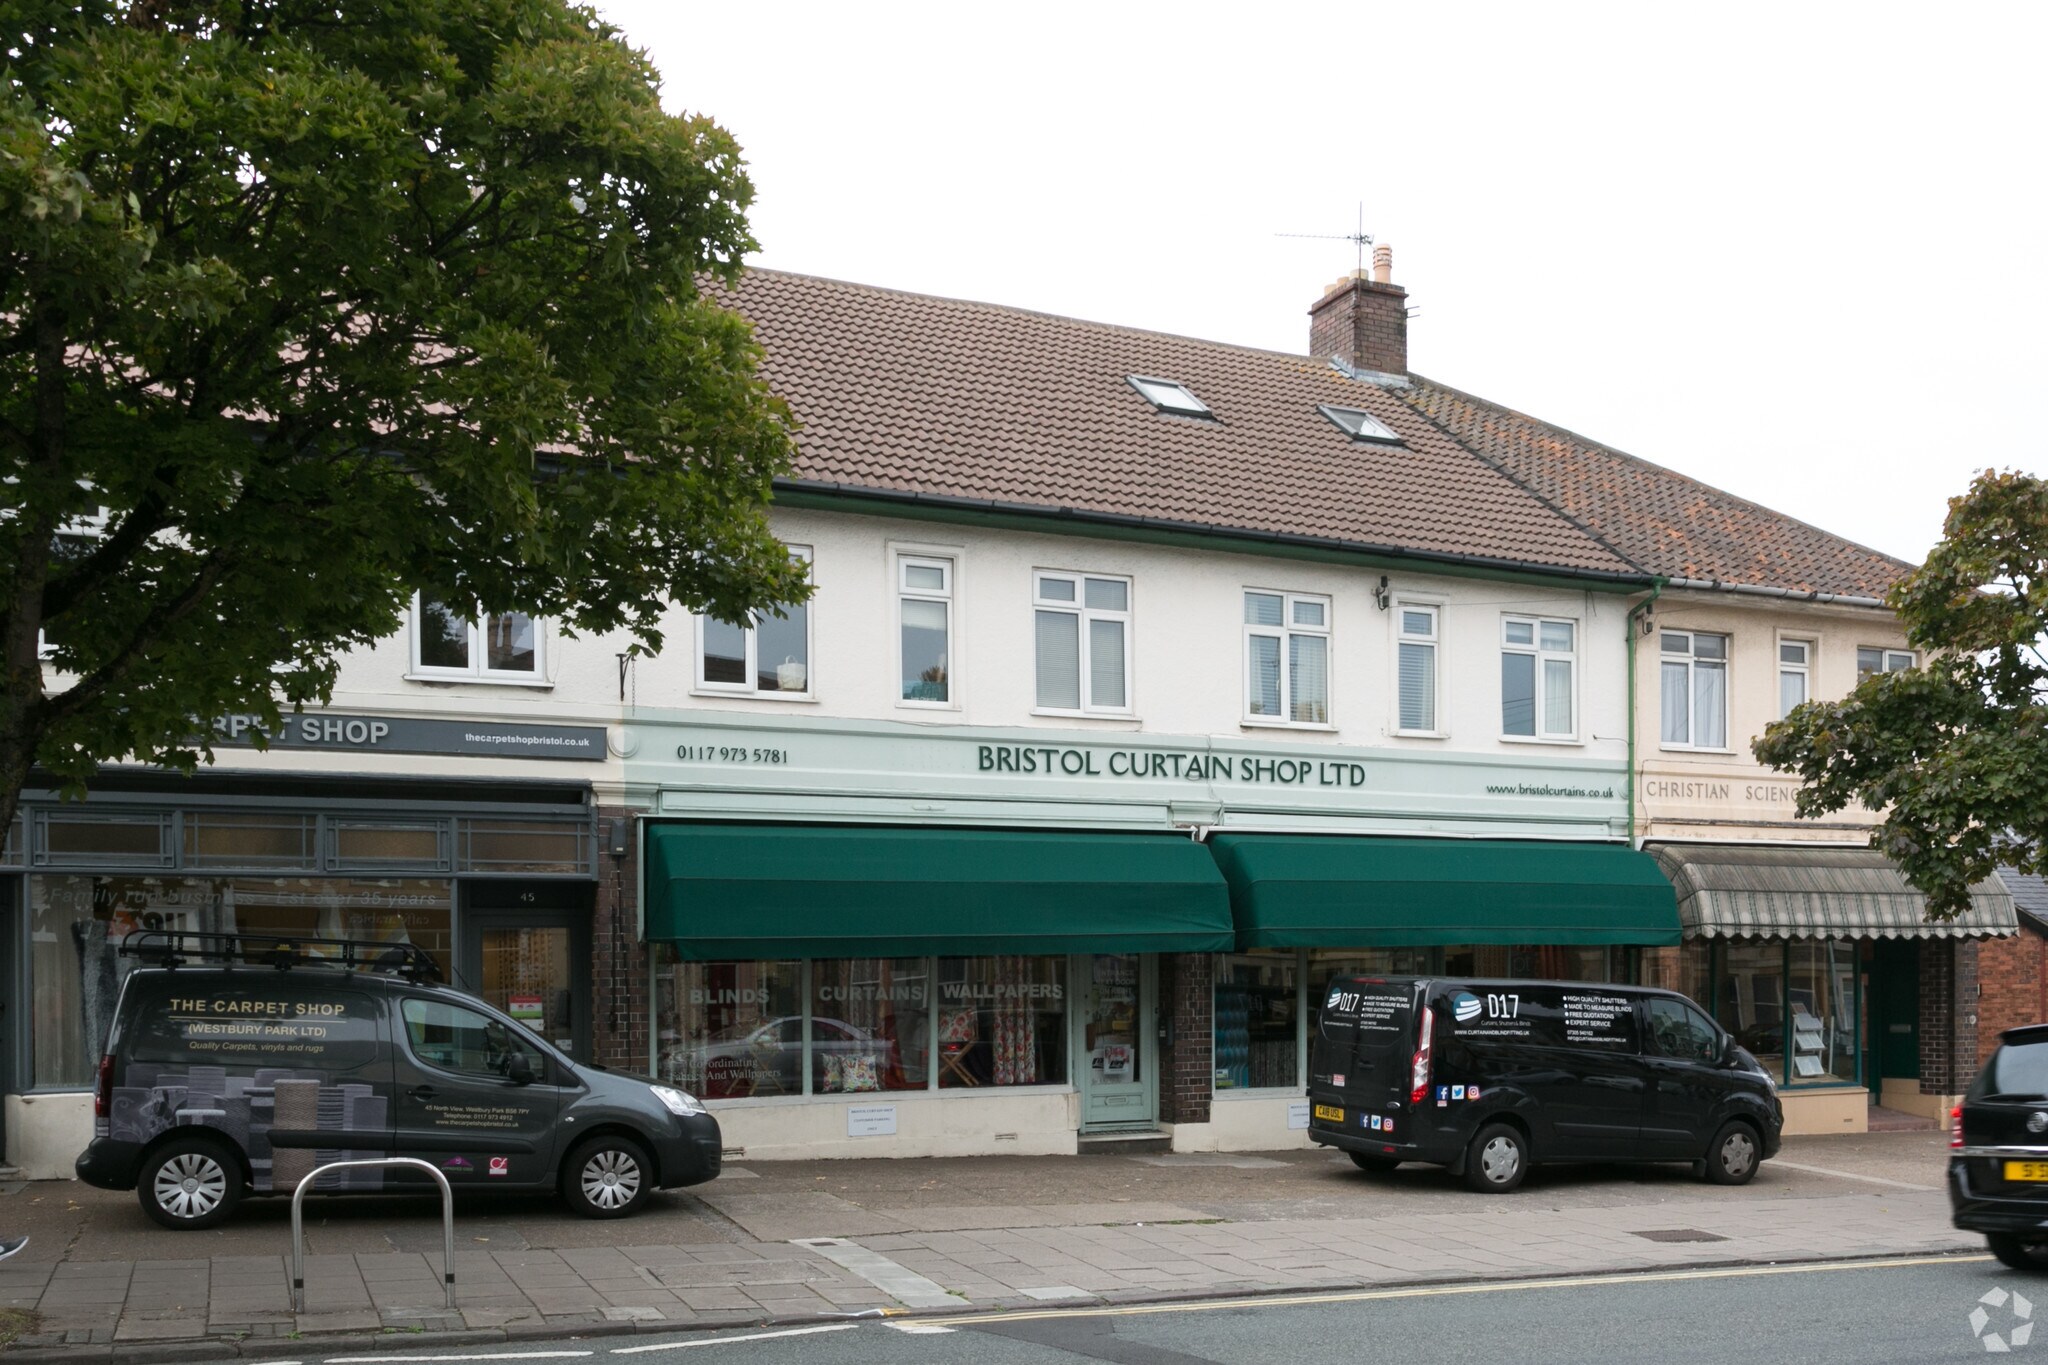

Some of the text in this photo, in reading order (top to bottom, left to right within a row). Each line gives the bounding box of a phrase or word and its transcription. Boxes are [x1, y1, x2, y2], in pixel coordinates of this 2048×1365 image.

[302, 718, 389, 744] SHOP
[465, 733, 590, 746] thecarpetshopbristol.co.uk
[677, 745, 787, 763] 0117 973 5781
[978, 746, 1365, 786] BRISTOL CURTAIN SHOP LTD
[1486, 783, 1614, 798] www.bristolcurtains.co.uk
[1646, 781, 1800, 802] CHRISTIAN SCIENC
[50, 888, 116, 905] Family
[361, 891, 381, 905] 35
[388, 893, 436, 908] years
[520, 893, 535, 901] 45
[690, 988, 770, 1004] BLINDS
[819, 986, 923, 1001] CURTAINS
[943, 984, 1063, 999] WALLPAPERS
[170, 999, 345, 1016] THE CARPET SHOP
[1488, 993, 1519, 1018] D17
[188, 1023, 327, 1038] (WESTBURY PARK LTD)
[189, 1040, 324, 1054] Quality Carpets, vinyls and rugs
[707, 1071, 726, 1080] And
[729, 1069, 782, 1081] Wallpapers
